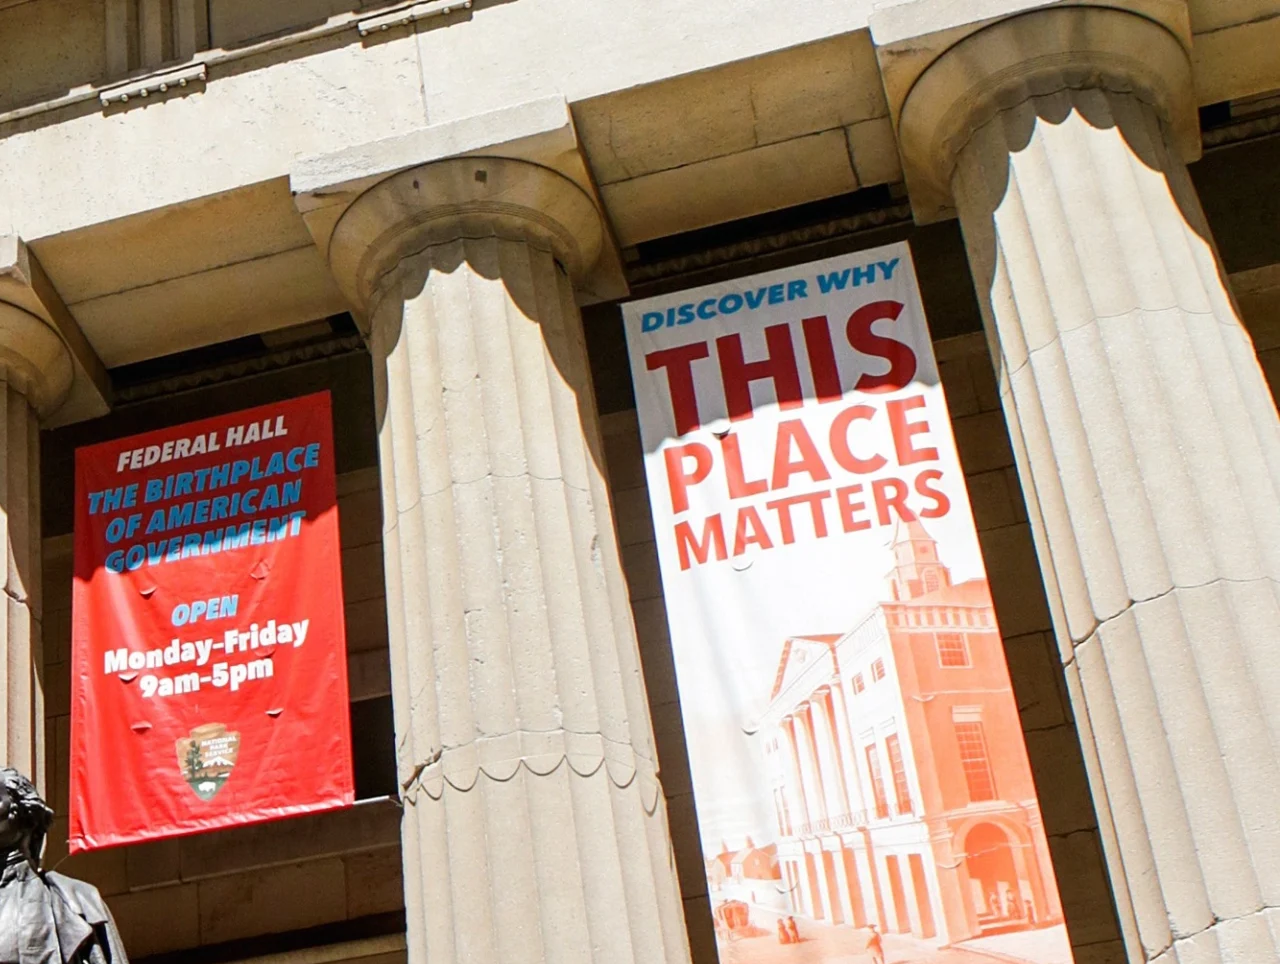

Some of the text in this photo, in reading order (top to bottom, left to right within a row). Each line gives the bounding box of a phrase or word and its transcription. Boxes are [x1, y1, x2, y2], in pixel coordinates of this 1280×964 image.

[642, 257, 900, 332] DISCOVER WHY
[645, 299, 918, 436] THIS
[117, 415, 288, 472] FEDERAL HALL
[664, 395, 939, 514] PLACE
[88, 443, 321, 514] THE BIRTHPLACE
[104, 511, 306, 574] GOVERNMENT
[106, 479, 302, 544] OF AMERICAN
[673, 470, 951, 571] MATTERS
[171, 594, 239, 626] OPEN
[104, 619, 309, 674] Monday-Friday
[139, 657, 274, 698] 9am-5pm
